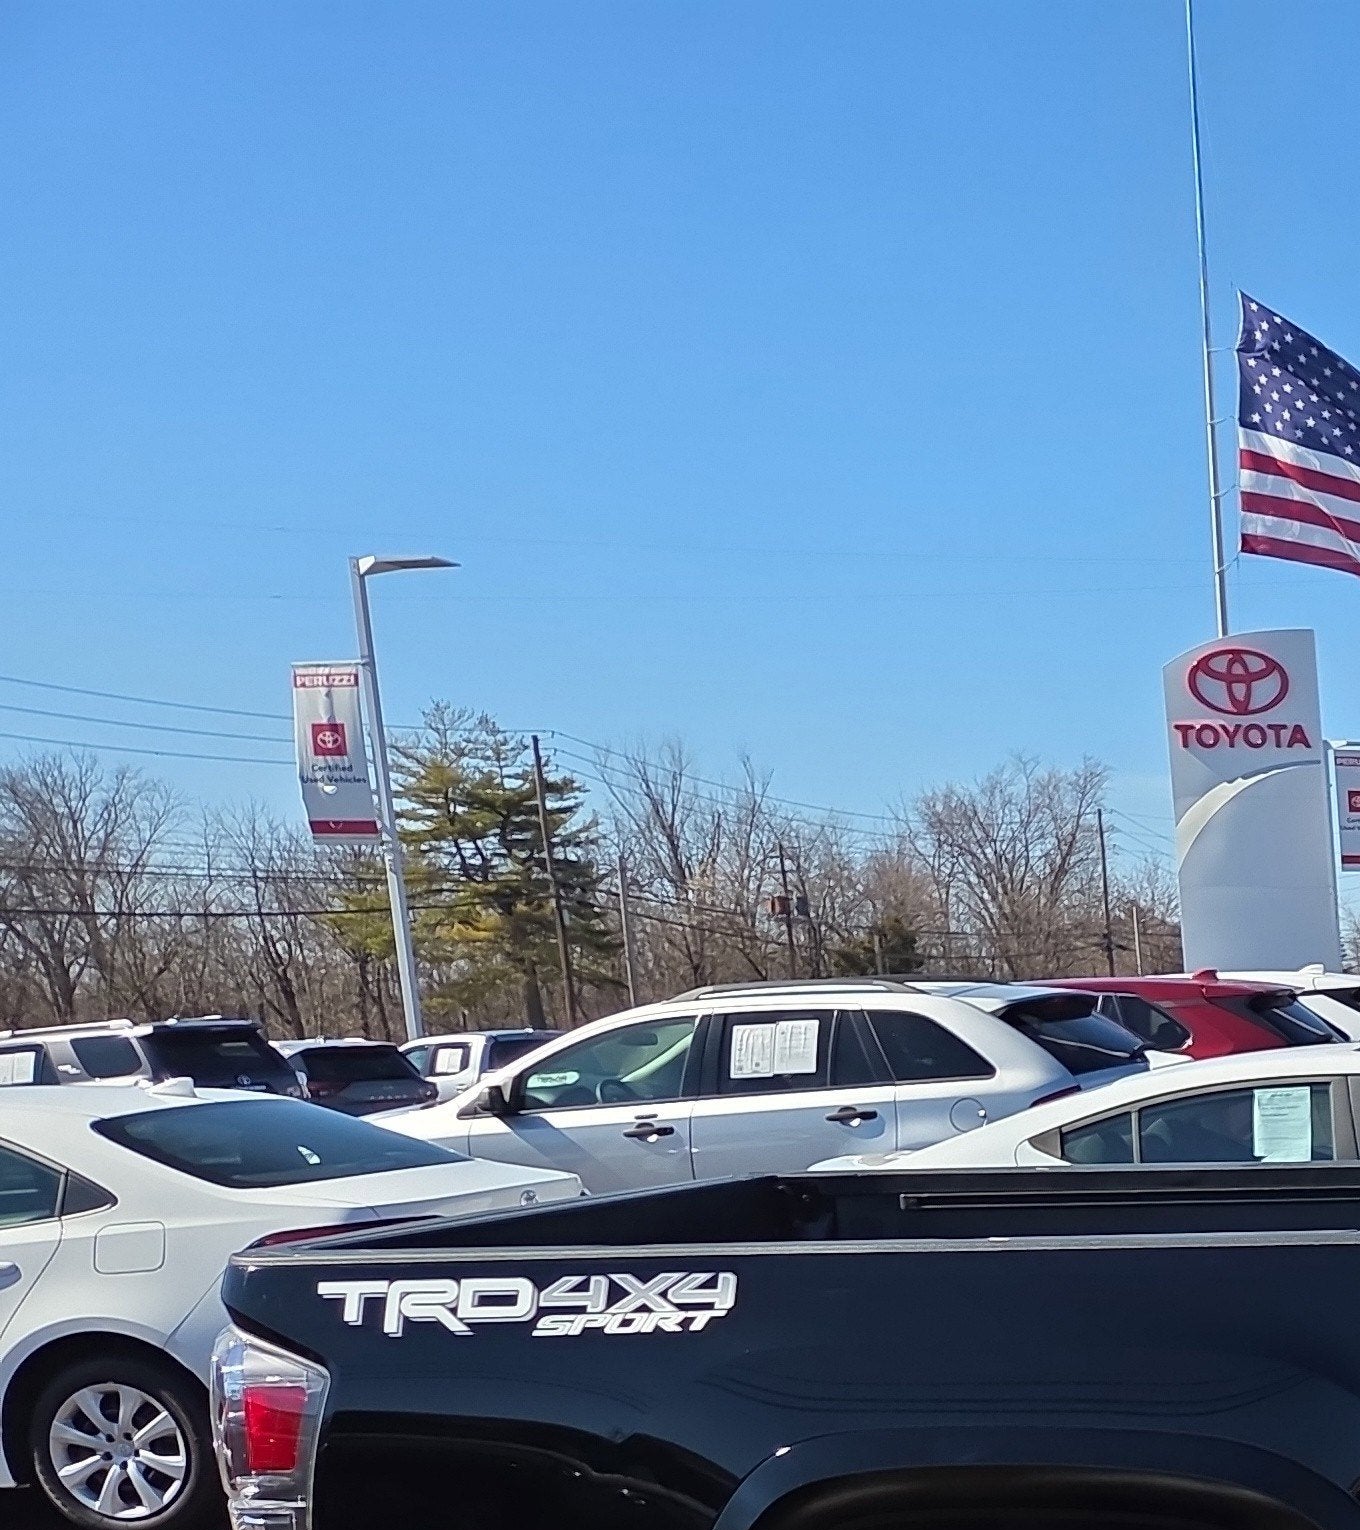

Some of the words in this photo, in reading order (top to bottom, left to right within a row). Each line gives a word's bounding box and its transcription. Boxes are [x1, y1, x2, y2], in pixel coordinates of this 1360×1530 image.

[296, 674, 355, 687] PERUZZI
[1173, 723, 1312, 749] TOYOTA
[311, 763, 353, 772] Certified
[327, 775, 367, 784] Vehicles
[316, 1277, 540, 1337] TRD
[531, 1308, 729, 1337] SPORT
